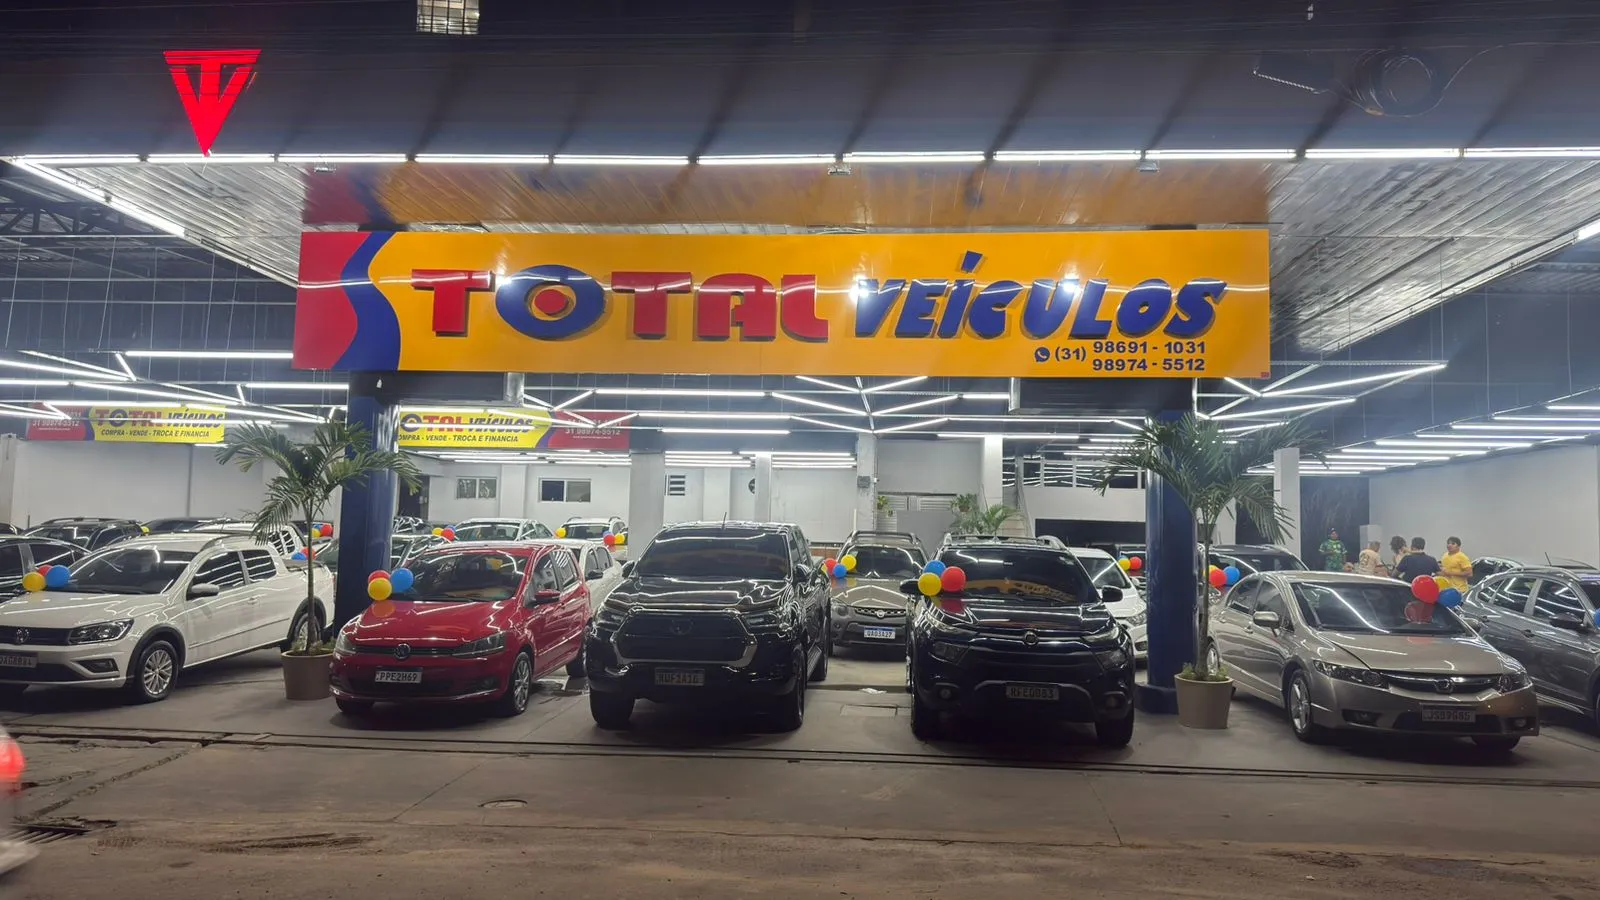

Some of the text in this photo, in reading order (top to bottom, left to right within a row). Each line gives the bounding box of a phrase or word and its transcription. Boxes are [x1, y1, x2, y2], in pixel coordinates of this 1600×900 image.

[411, 250, 1228, 343] TOTAL VEÍCULOS
[1055, 346, 1087, 362] (31)
[1093, 341, 1148, 354] 98691
[1164, 341, 1206, 354] 1031
[1092, 358, 1148, 371] 98974
[1162, 358, 1206, 371] 5512
[400, 413, 464, 433] OTAL
[130, 429, 148, 437] VENDE
[153, 429, 173, 437] TROCA
[180, 430, 210, 438] FINANCIA
[453, 434, 477, 442] TROCA
[380, 671, 418, 682] PPE2H69
